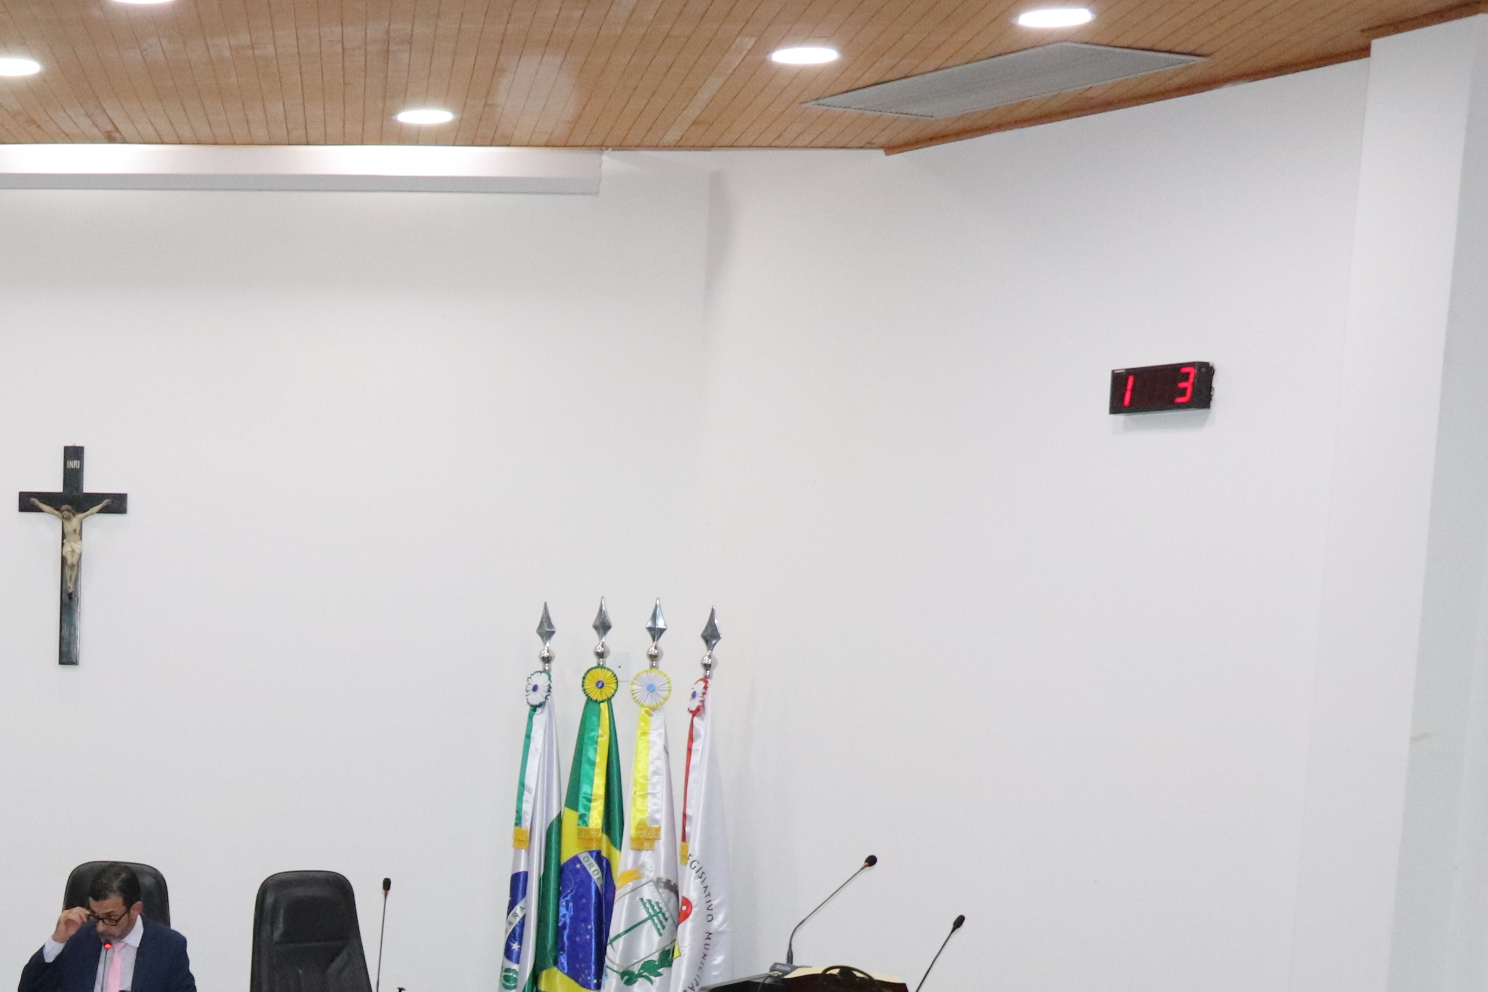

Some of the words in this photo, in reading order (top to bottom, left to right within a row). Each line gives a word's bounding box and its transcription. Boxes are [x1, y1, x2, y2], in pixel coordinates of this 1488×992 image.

[1123, 375, 1134, 407] 1
[1174, 366, 1196, 404] 3
[67, 460, 80, 469] INRI
